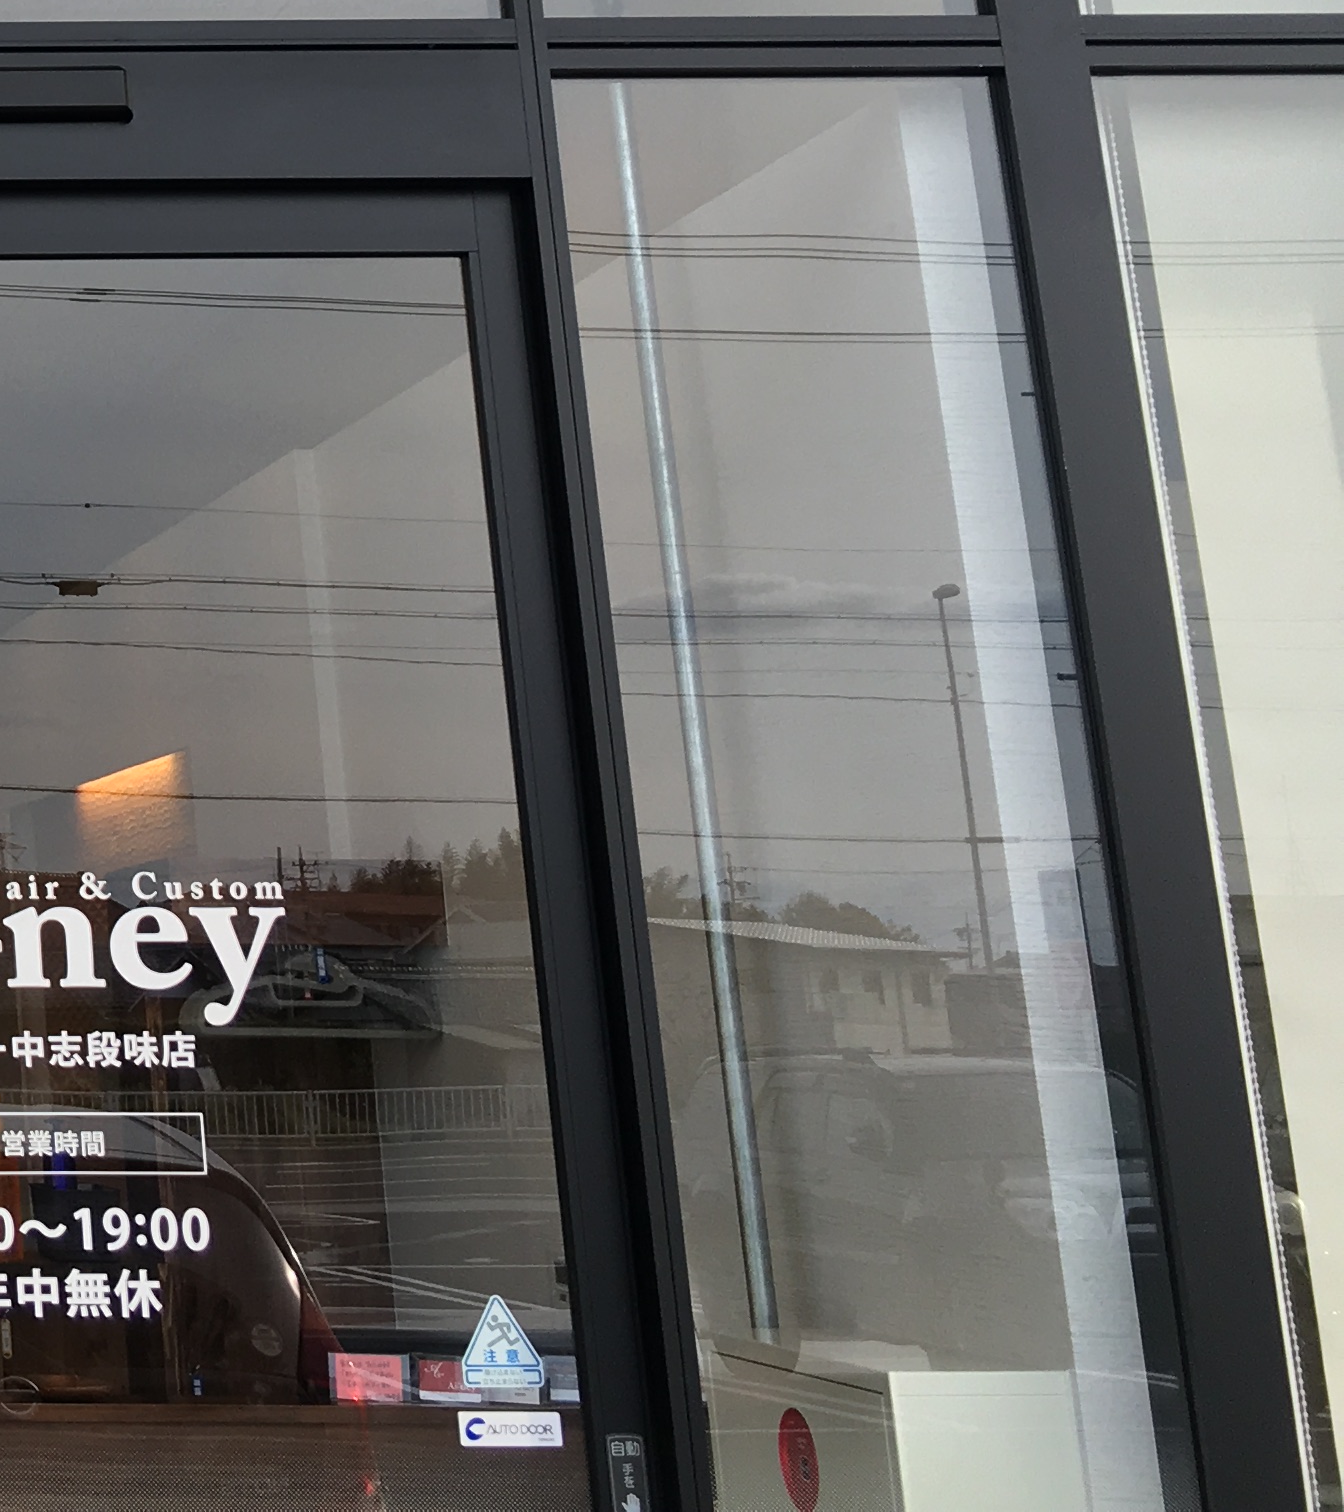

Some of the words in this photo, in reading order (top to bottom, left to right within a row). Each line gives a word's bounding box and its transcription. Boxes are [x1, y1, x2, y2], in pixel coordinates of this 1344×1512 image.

[78, 871, 112, 901] &
[130, 871, 285, 901] Custom
[0, 1129, 107, 1158] 営業時間
[483, 1348, 521, 1364] 注意
[486, 1425, 518, 1435] AUTO
[520, 1424, 554, 1435] DOOR
[611, 1440, 641, 1457] 自動
